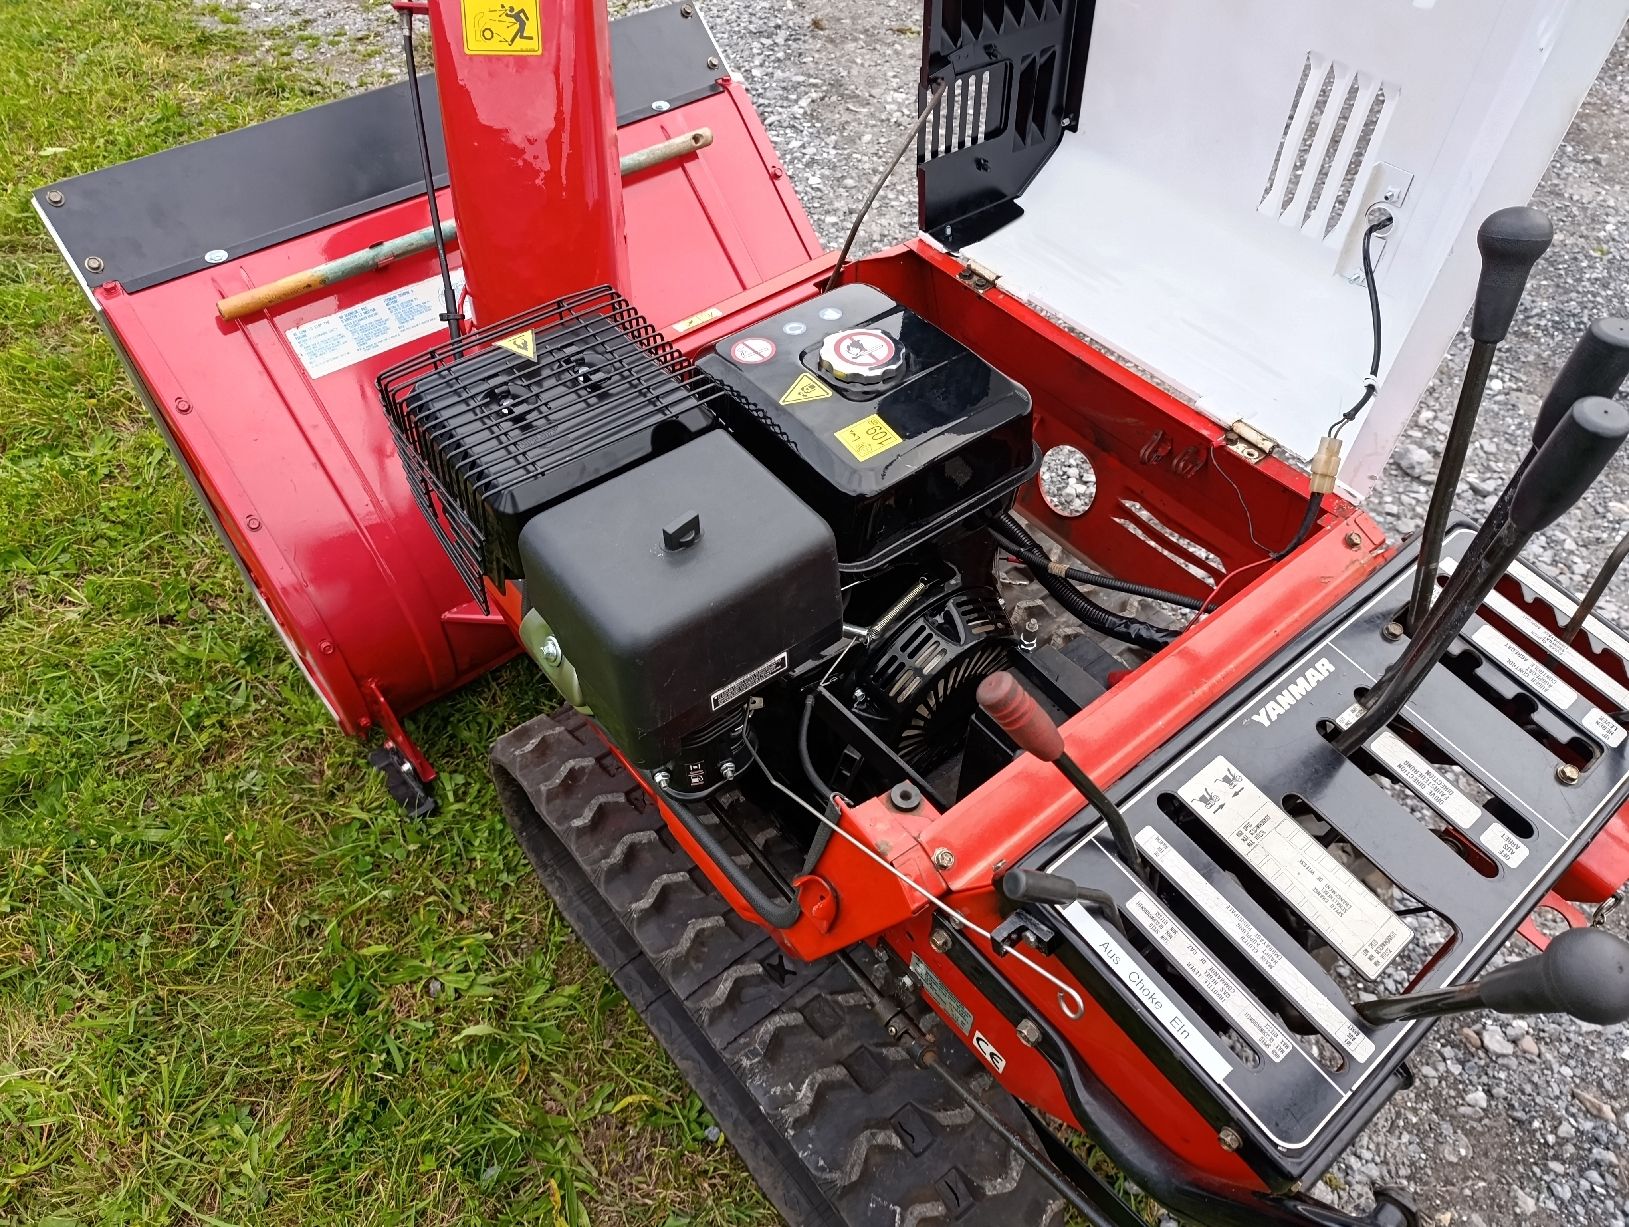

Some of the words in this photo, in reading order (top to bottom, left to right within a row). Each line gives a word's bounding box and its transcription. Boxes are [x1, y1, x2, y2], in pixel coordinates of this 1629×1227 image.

[865, 424, 891, 445] 109
[1250, 655, 1336, 731] YANMAR
[1396, 762, 1426, 790] DIRECTION
[1423, 768, 1454, 796] DIRECTION
[1426, 788, 1444, 805] DRIVE
[1500, 831, 1520, 851] ARRET
[1501, 842, 1516, 856] AUS
[1497, 847, 1511, 861] OFF
[1097, 938, 1124, 965] Aus
[1126, 969, 1166, 1011] Choke
[977, 1037, 1002, 1070] CE
